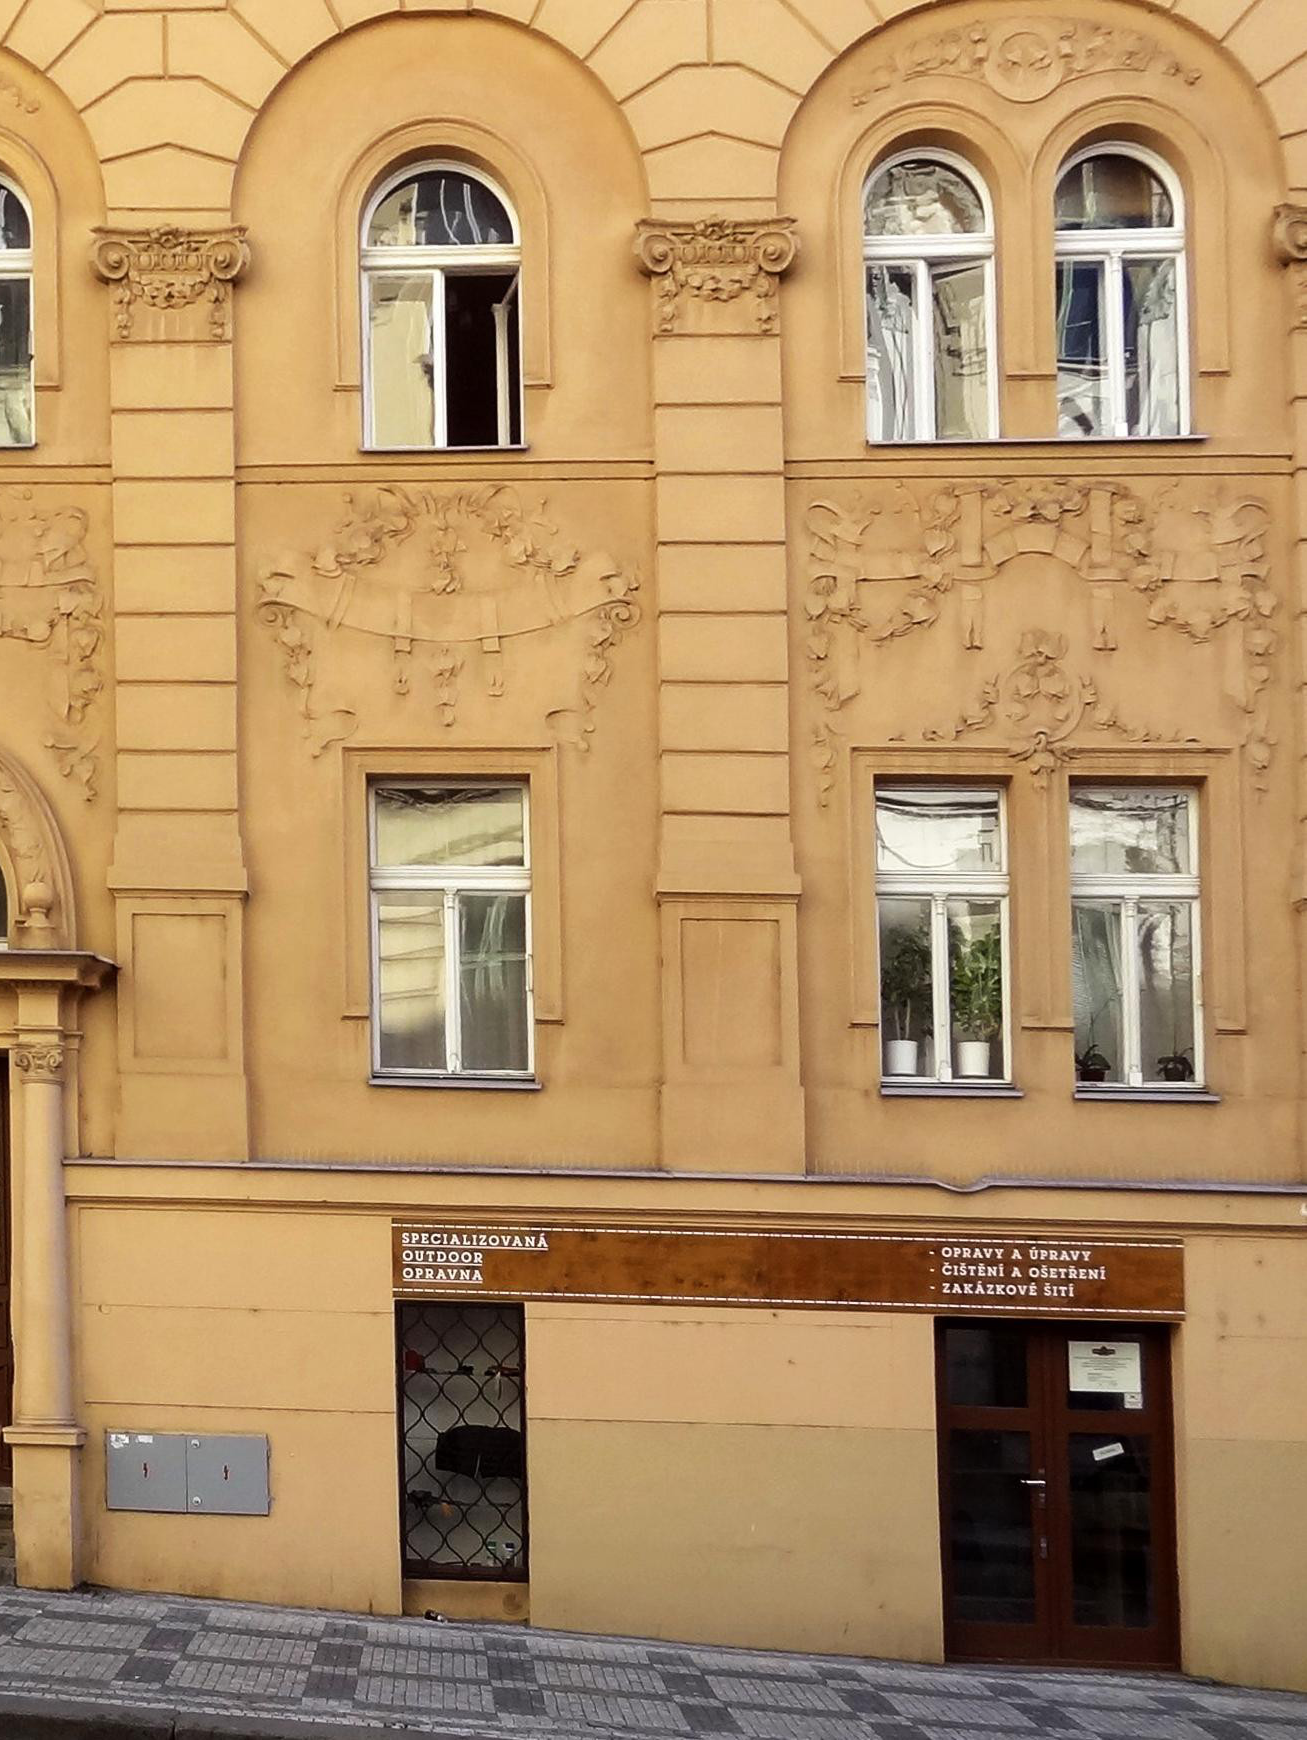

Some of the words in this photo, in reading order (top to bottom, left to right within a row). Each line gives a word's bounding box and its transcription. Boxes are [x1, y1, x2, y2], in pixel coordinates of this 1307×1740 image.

[402, 1233, 548, 1248] SPECIALIZOVANÁ
[402, 1250, 483, 1263] OUTDOOR
[942, 1247, 1004, 1259] OPRAVY
[1011, 1249, 1022, 1260] A
[1030, 1246, 1092, 1261] ÚPRAVY
[402, 1267, 483, 1281] OPRAVNA
[942, 1262, 1005, 1277] ČIŠTĚNÍ
[1011, 1266, 1022, 1278] A
[1029, 1265, 1107, 1280] OŠETŘENÍ
[942, 1281, 1037, 1296] ZAKÁZKOVÉ
[1044, 1282, 1075, 1297] ŠITÍ
